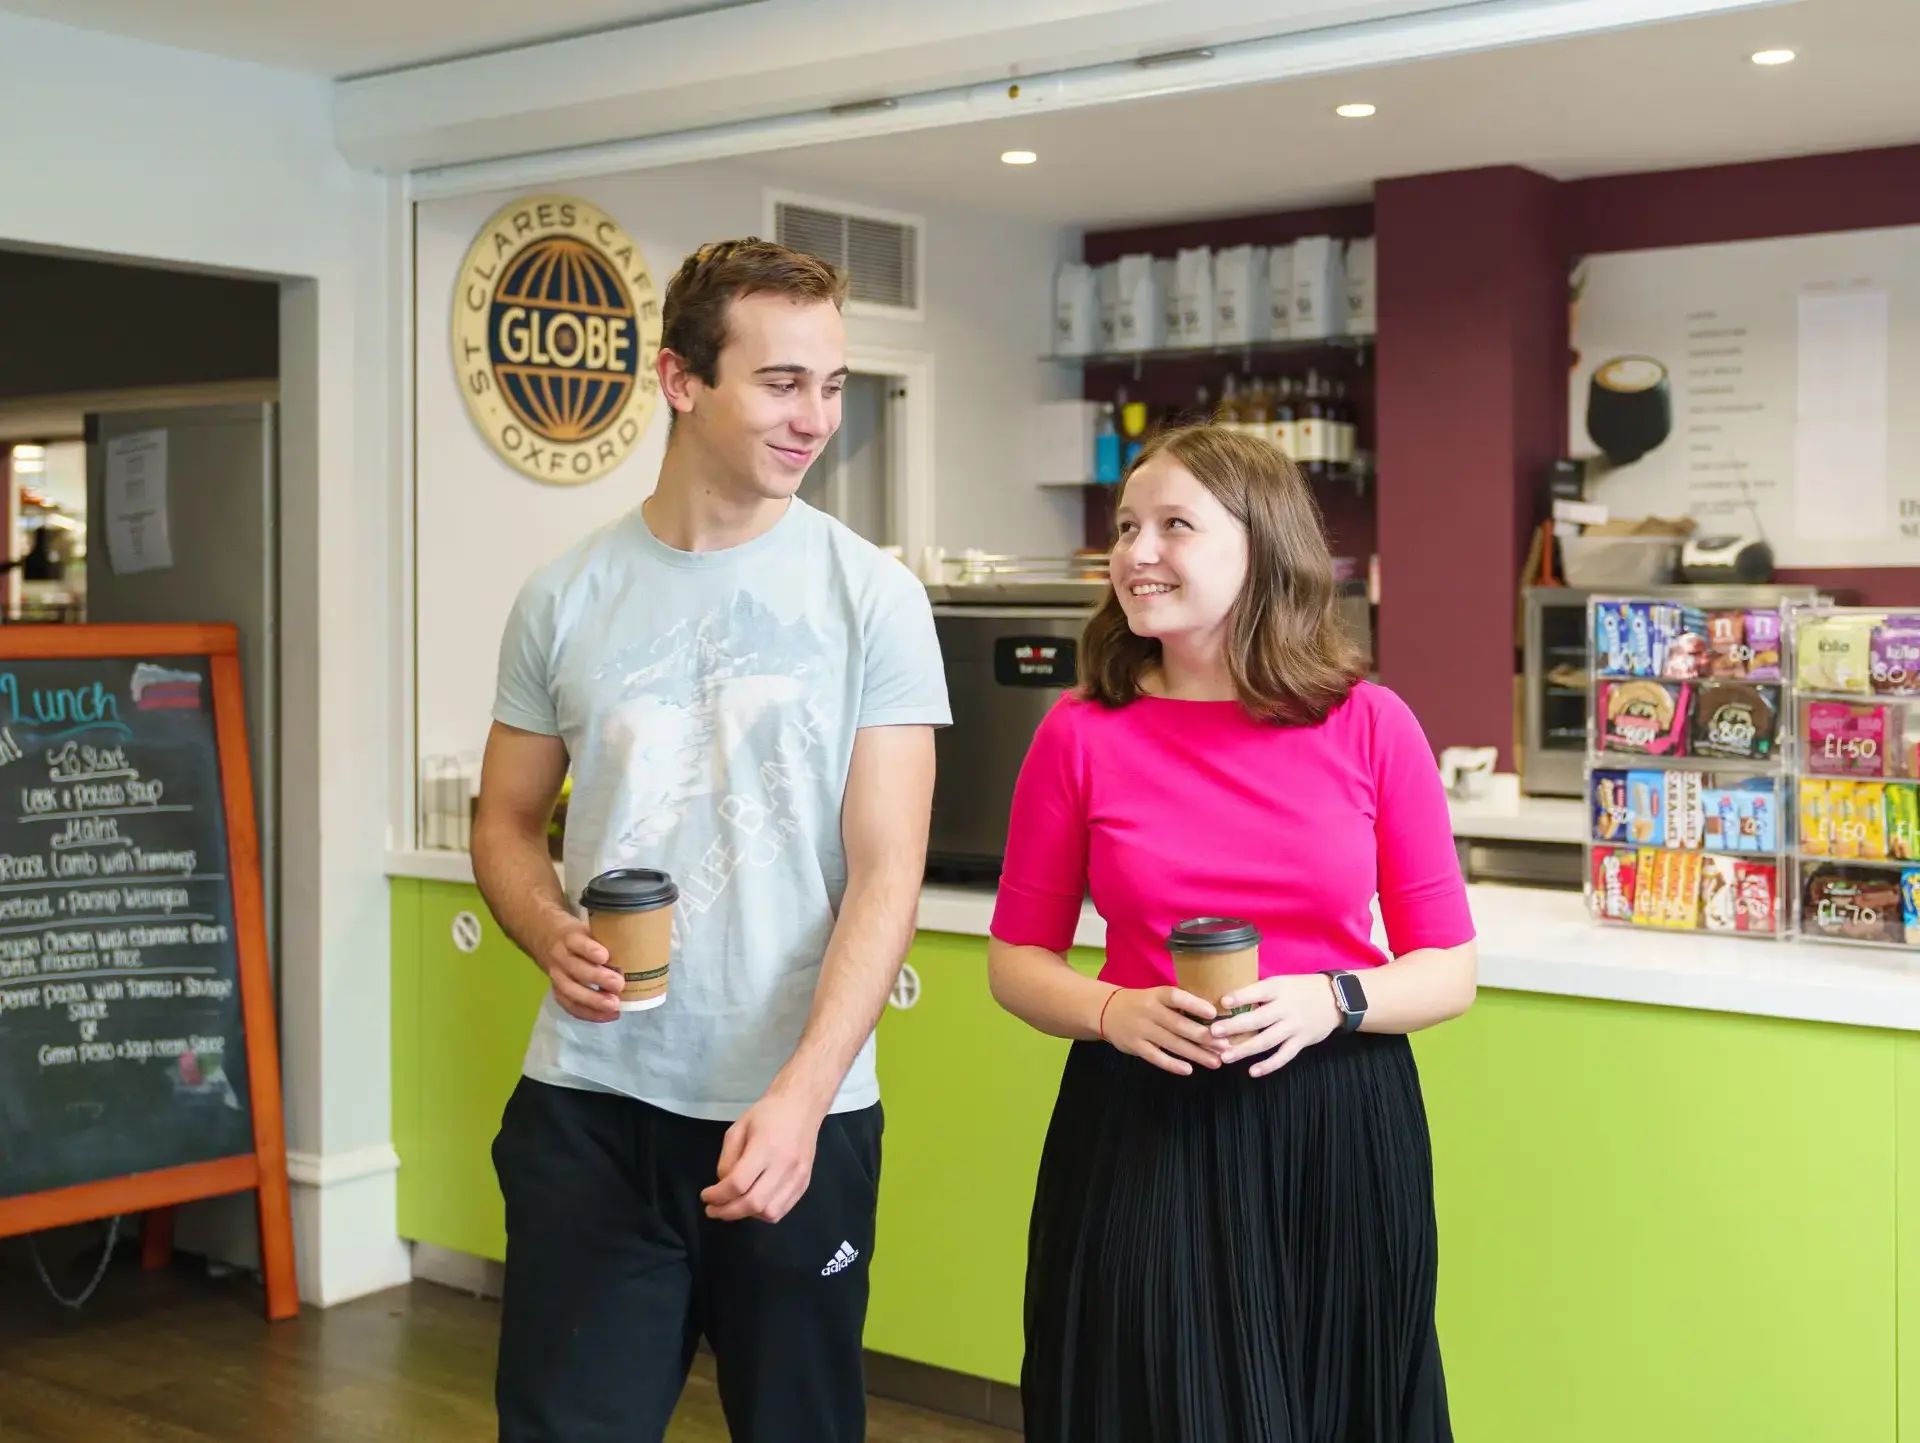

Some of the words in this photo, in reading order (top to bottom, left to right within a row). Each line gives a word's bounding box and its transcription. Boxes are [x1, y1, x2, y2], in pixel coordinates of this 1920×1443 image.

[466, 203, 577, 313] CLARES
[465, 337, 491, 396] ST
[500, 306, 631, 372] GLOBE
[502, 418, 639, 475] OXFORD
[0, 673, 119, 724] Lunch
[821, 1249, 859, 1276] adidas
